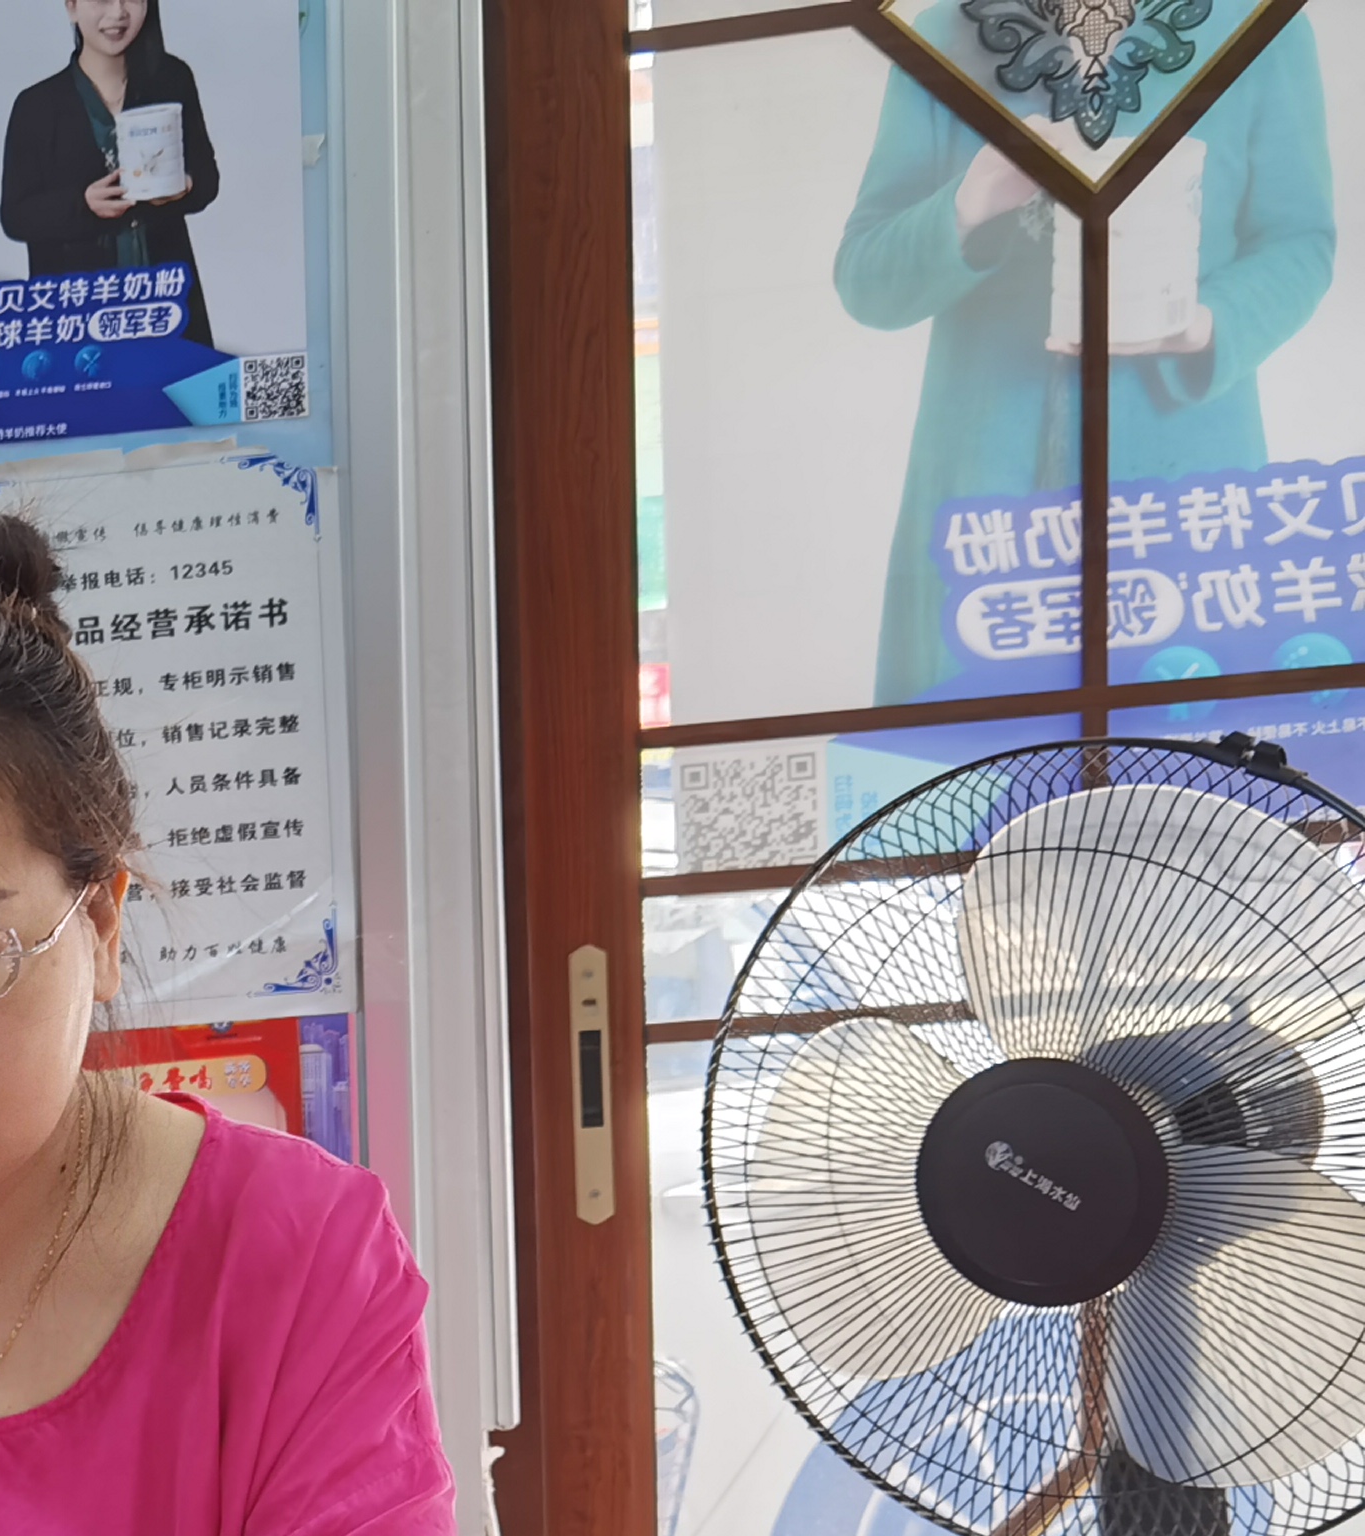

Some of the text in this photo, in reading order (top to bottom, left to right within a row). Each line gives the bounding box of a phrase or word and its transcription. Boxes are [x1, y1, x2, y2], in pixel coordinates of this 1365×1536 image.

[74, 597, 289, 646] 品经营承诺书
[129, 766, 302, 800] ，人员条件具备
